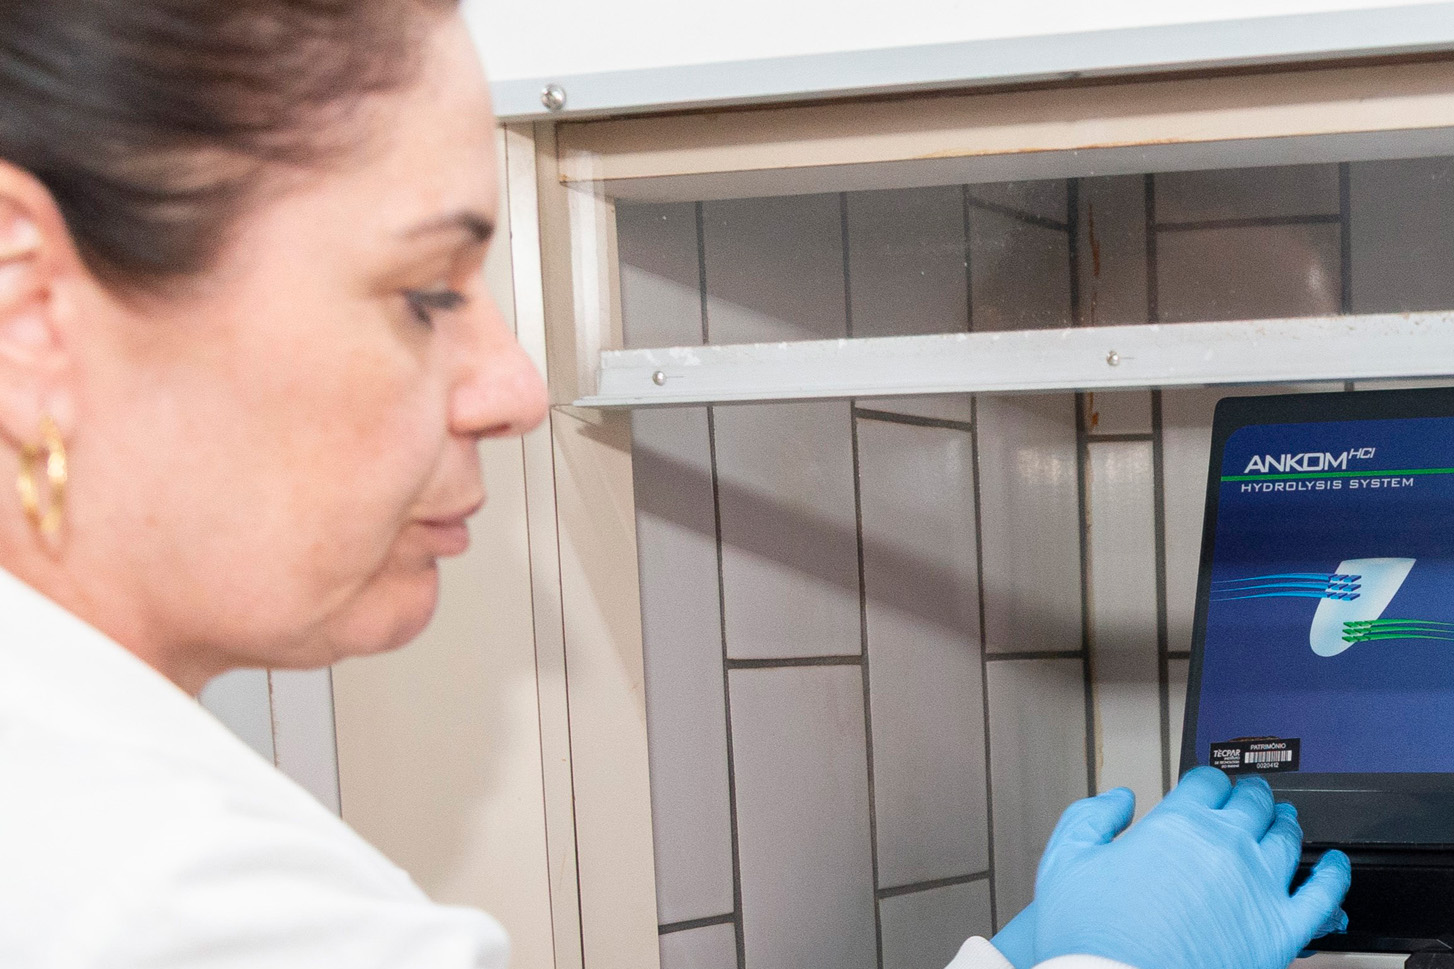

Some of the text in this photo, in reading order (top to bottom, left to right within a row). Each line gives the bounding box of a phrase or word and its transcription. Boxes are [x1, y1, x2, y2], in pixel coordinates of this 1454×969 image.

[1243, 451, 1349, 474] ANKOM
[1241, 477, 1415, 493] HYDROLYSIS SYSTEM
